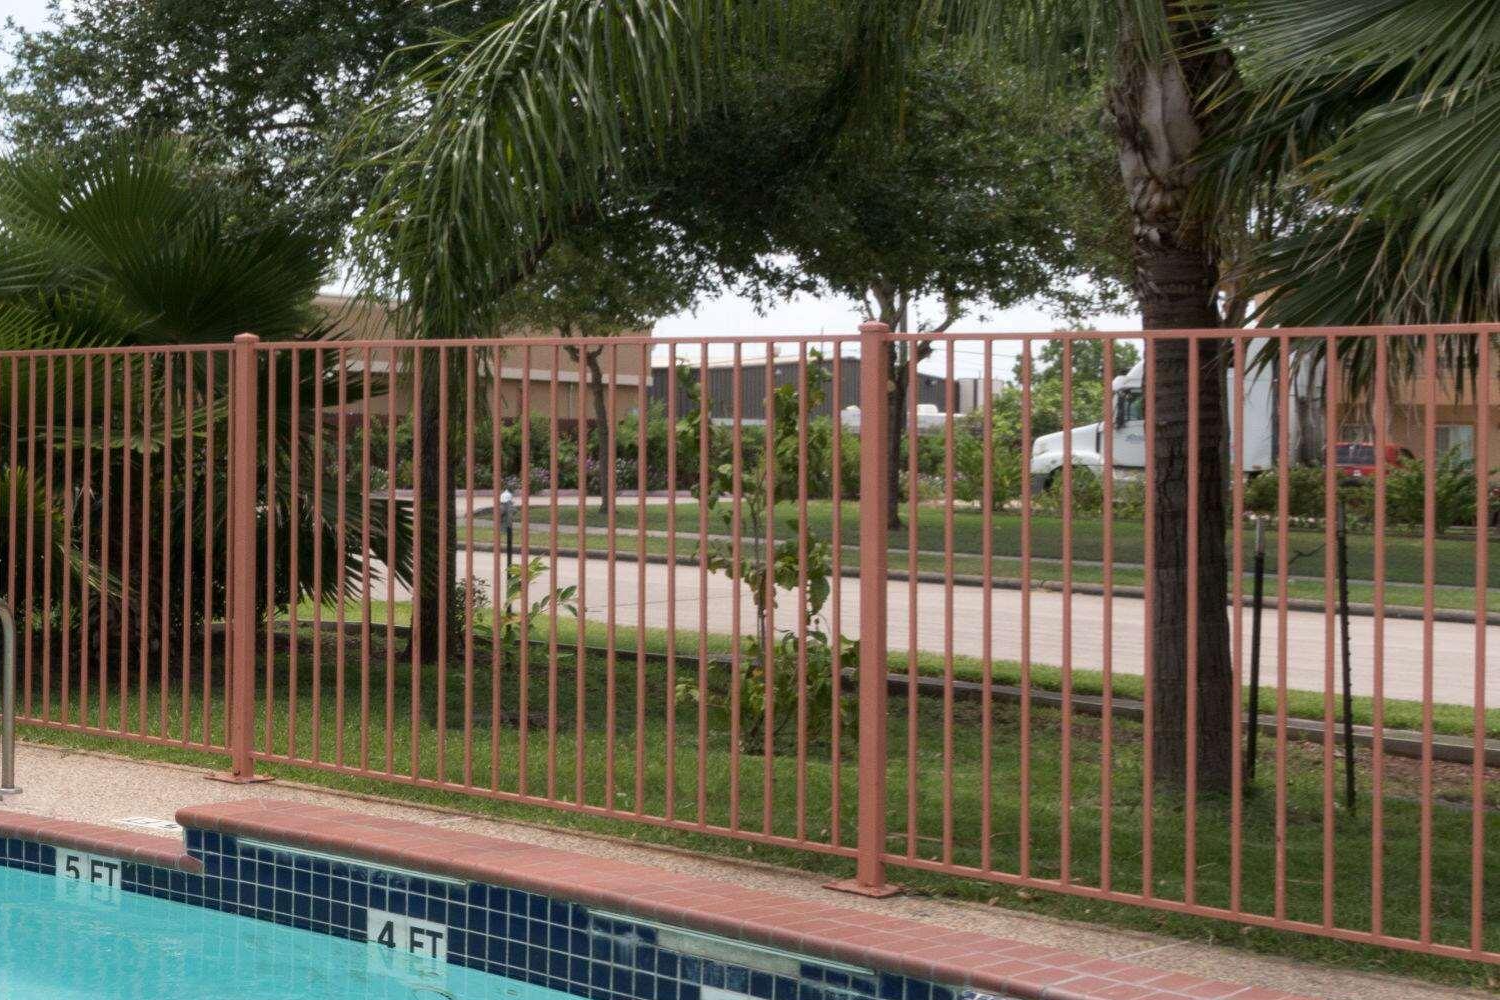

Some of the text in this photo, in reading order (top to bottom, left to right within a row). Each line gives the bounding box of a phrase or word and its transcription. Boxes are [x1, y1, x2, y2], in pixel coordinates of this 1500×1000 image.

[66, 855, 118, 887] 5 FT
[378, 920, 443, 958] 4 FT
